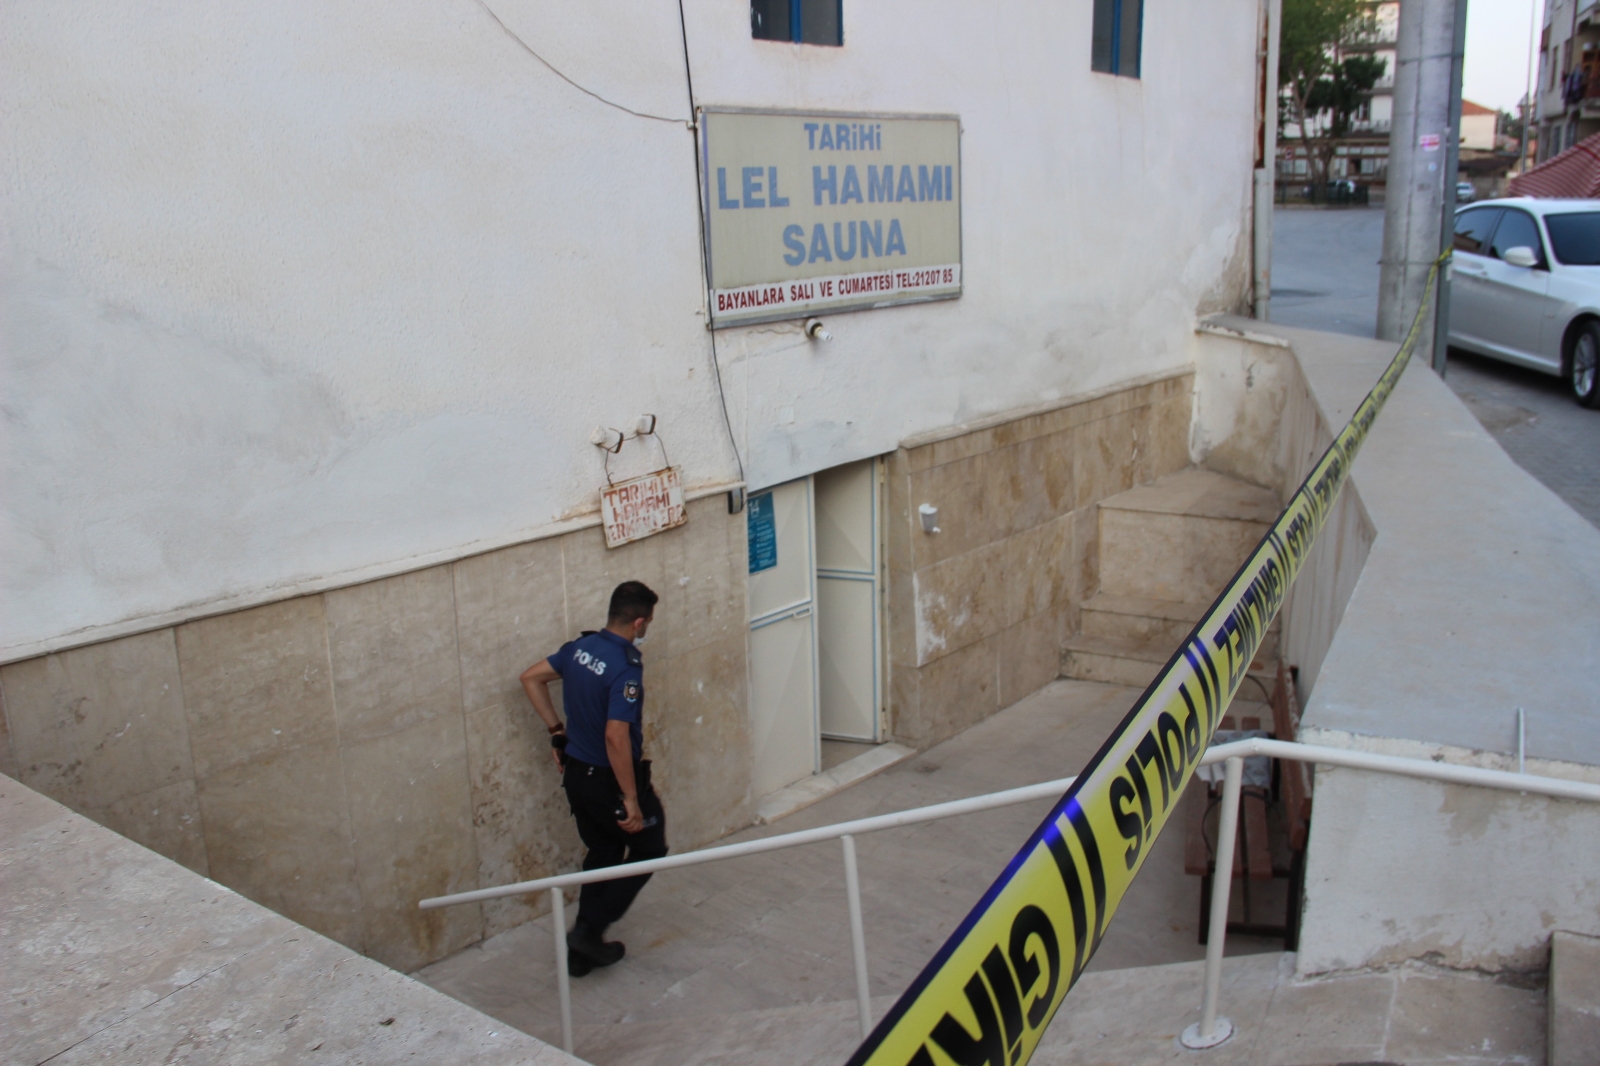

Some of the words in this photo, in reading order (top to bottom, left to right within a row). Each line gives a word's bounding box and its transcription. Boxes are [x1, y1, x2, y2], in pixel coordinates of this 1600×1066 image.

[717, 166, 790, 209] LEL
[812, 165, 952, 205] HAMAMI
[782, 218, 907, 266] SAUNA
[718, 286, 785, 311] BAYANLARA
[790, 282, 814, 301] SALI
[819, 280, 833, 297] VE
[943, 268, 953, 283] 85
